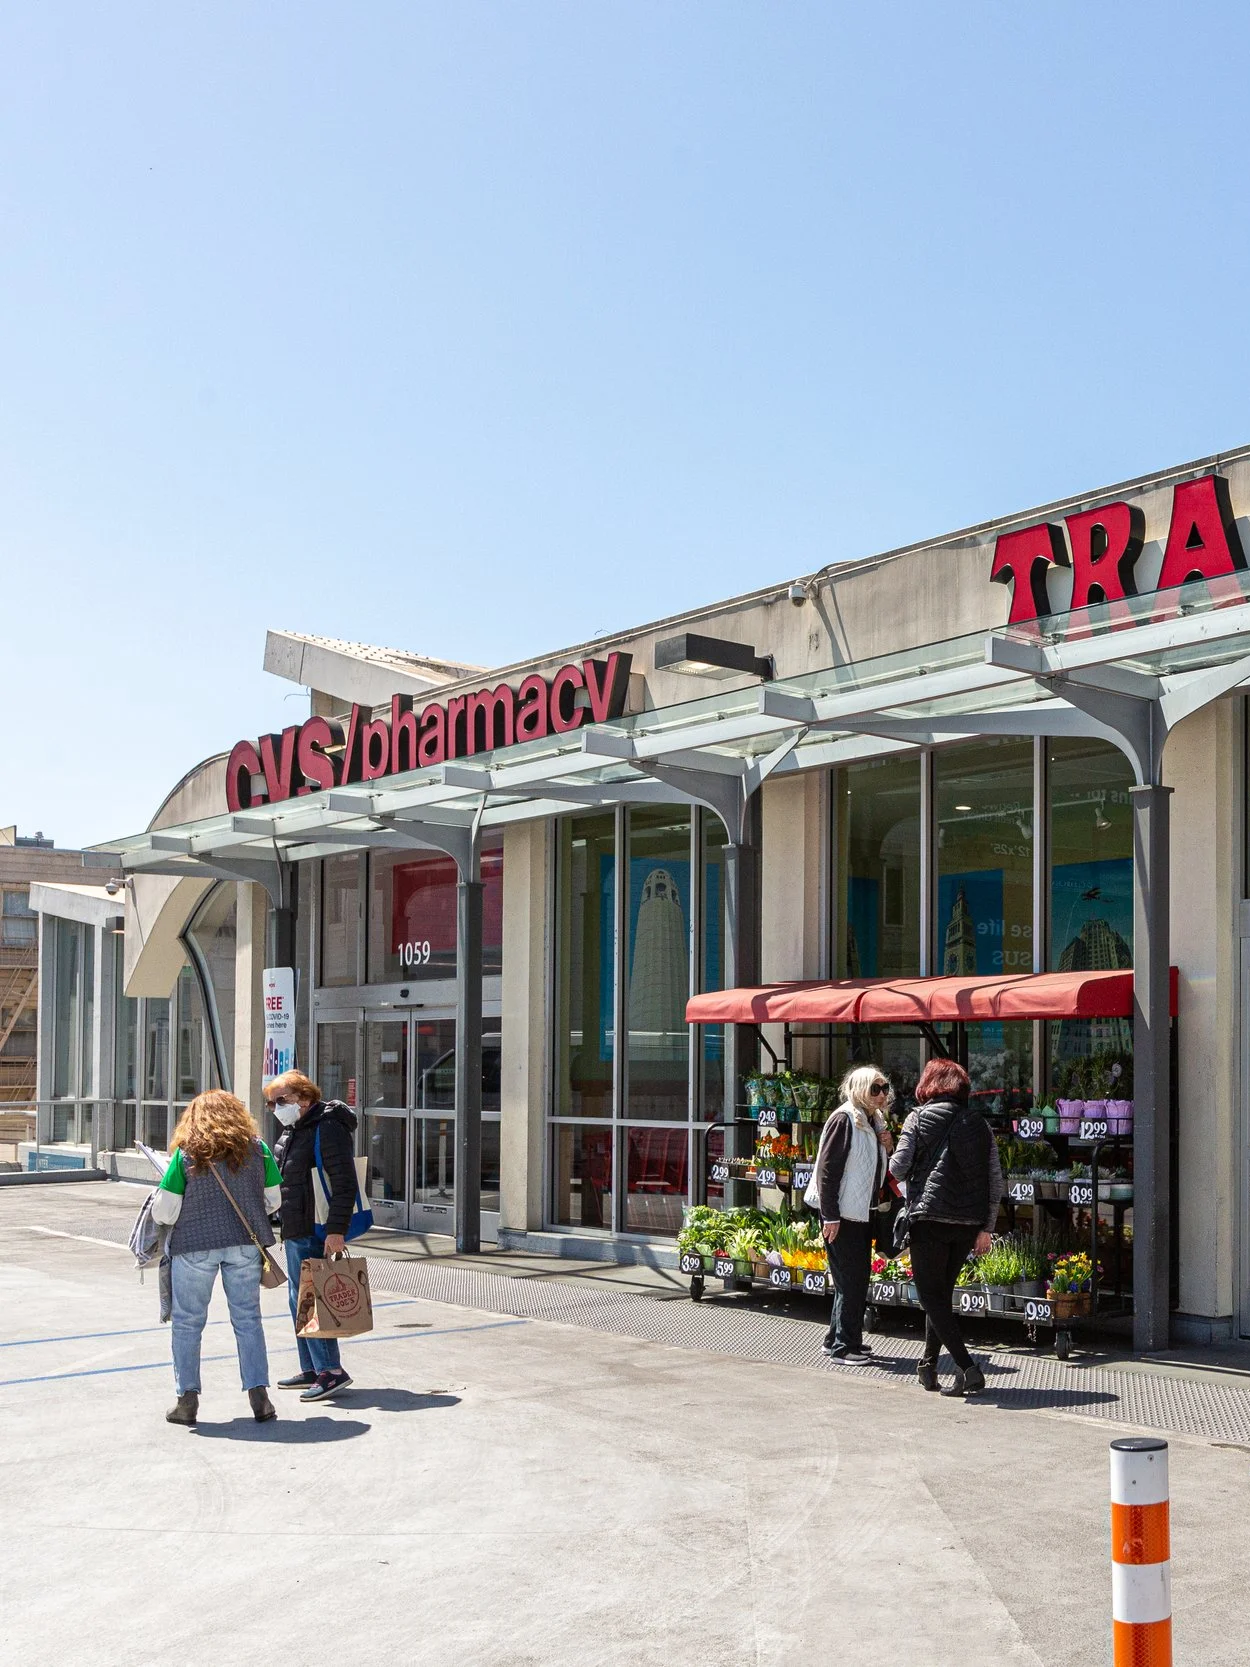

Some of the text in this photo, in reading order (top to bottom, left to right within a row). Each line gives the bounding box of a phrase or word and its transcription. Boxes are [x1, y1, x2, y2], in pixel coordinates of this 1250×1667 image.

[226, 651, 630, 812] CVS/pharmacy
[398, 940, 430, 966] 1059
[760, 1110, 776, 1126] 2.49
[1020, 1119, 1044, 1138] 3.99
[1080, 1121, 1107, 1139] 12.99
[712, 1164, 729, 1180] 2.99
[758, 1169, 776, 1185] 4.99
[1010, 1183, 1034, 1200] 4.99
[1071, 1185, 1093, 1204] 8.99
[681, 1254, 700, 1272] 3.99
[716, 1261, 734, 1277] 5.99
[771, 1268, 791, 1285] 6.99
[805, 1273, 825, 1290] 6.99
[329, 1288, 357, 1302] TRADER
[874, 1282, 895, 1300] 7.99
[335, 1297, 355, 1308] JOE'S
[961, 1293, 985, 1312] 9.99
[1026, 1301, 1051, 1320] 9.99
